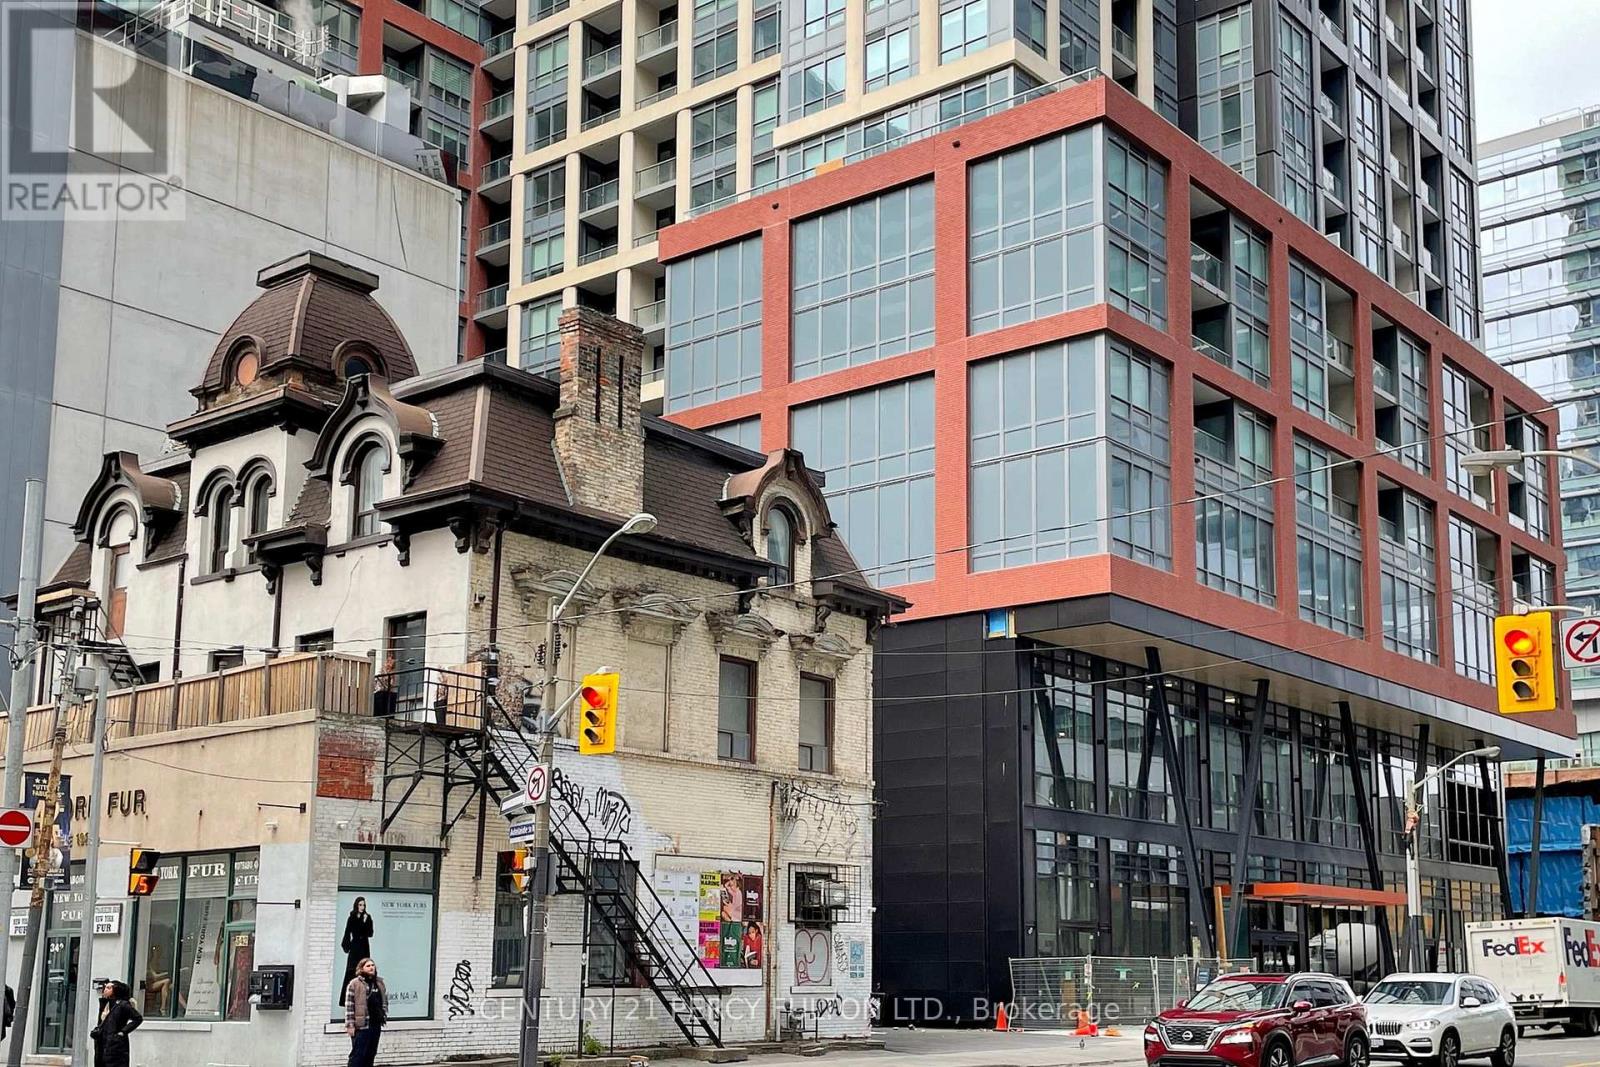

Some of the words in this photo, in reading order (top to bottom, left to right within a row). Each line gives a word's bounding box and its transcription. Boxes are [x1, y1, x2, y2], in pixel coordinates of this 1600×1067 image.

[188, 862, 226, 878] FUR
[341, 858, 360, 868] NEW
[362, 859, 382, 869] YORK
[392, 860, 432, 873] FUR
[160, 865, 179, 880] YORK
[139, 876, 149, 893] 5
[53, 893, 70, 904] NEW
[96, 923, 112, 933] FUR
[1482, 936, 1546, 957] FedEx
[1563, 927, 1600, 968] FedE
